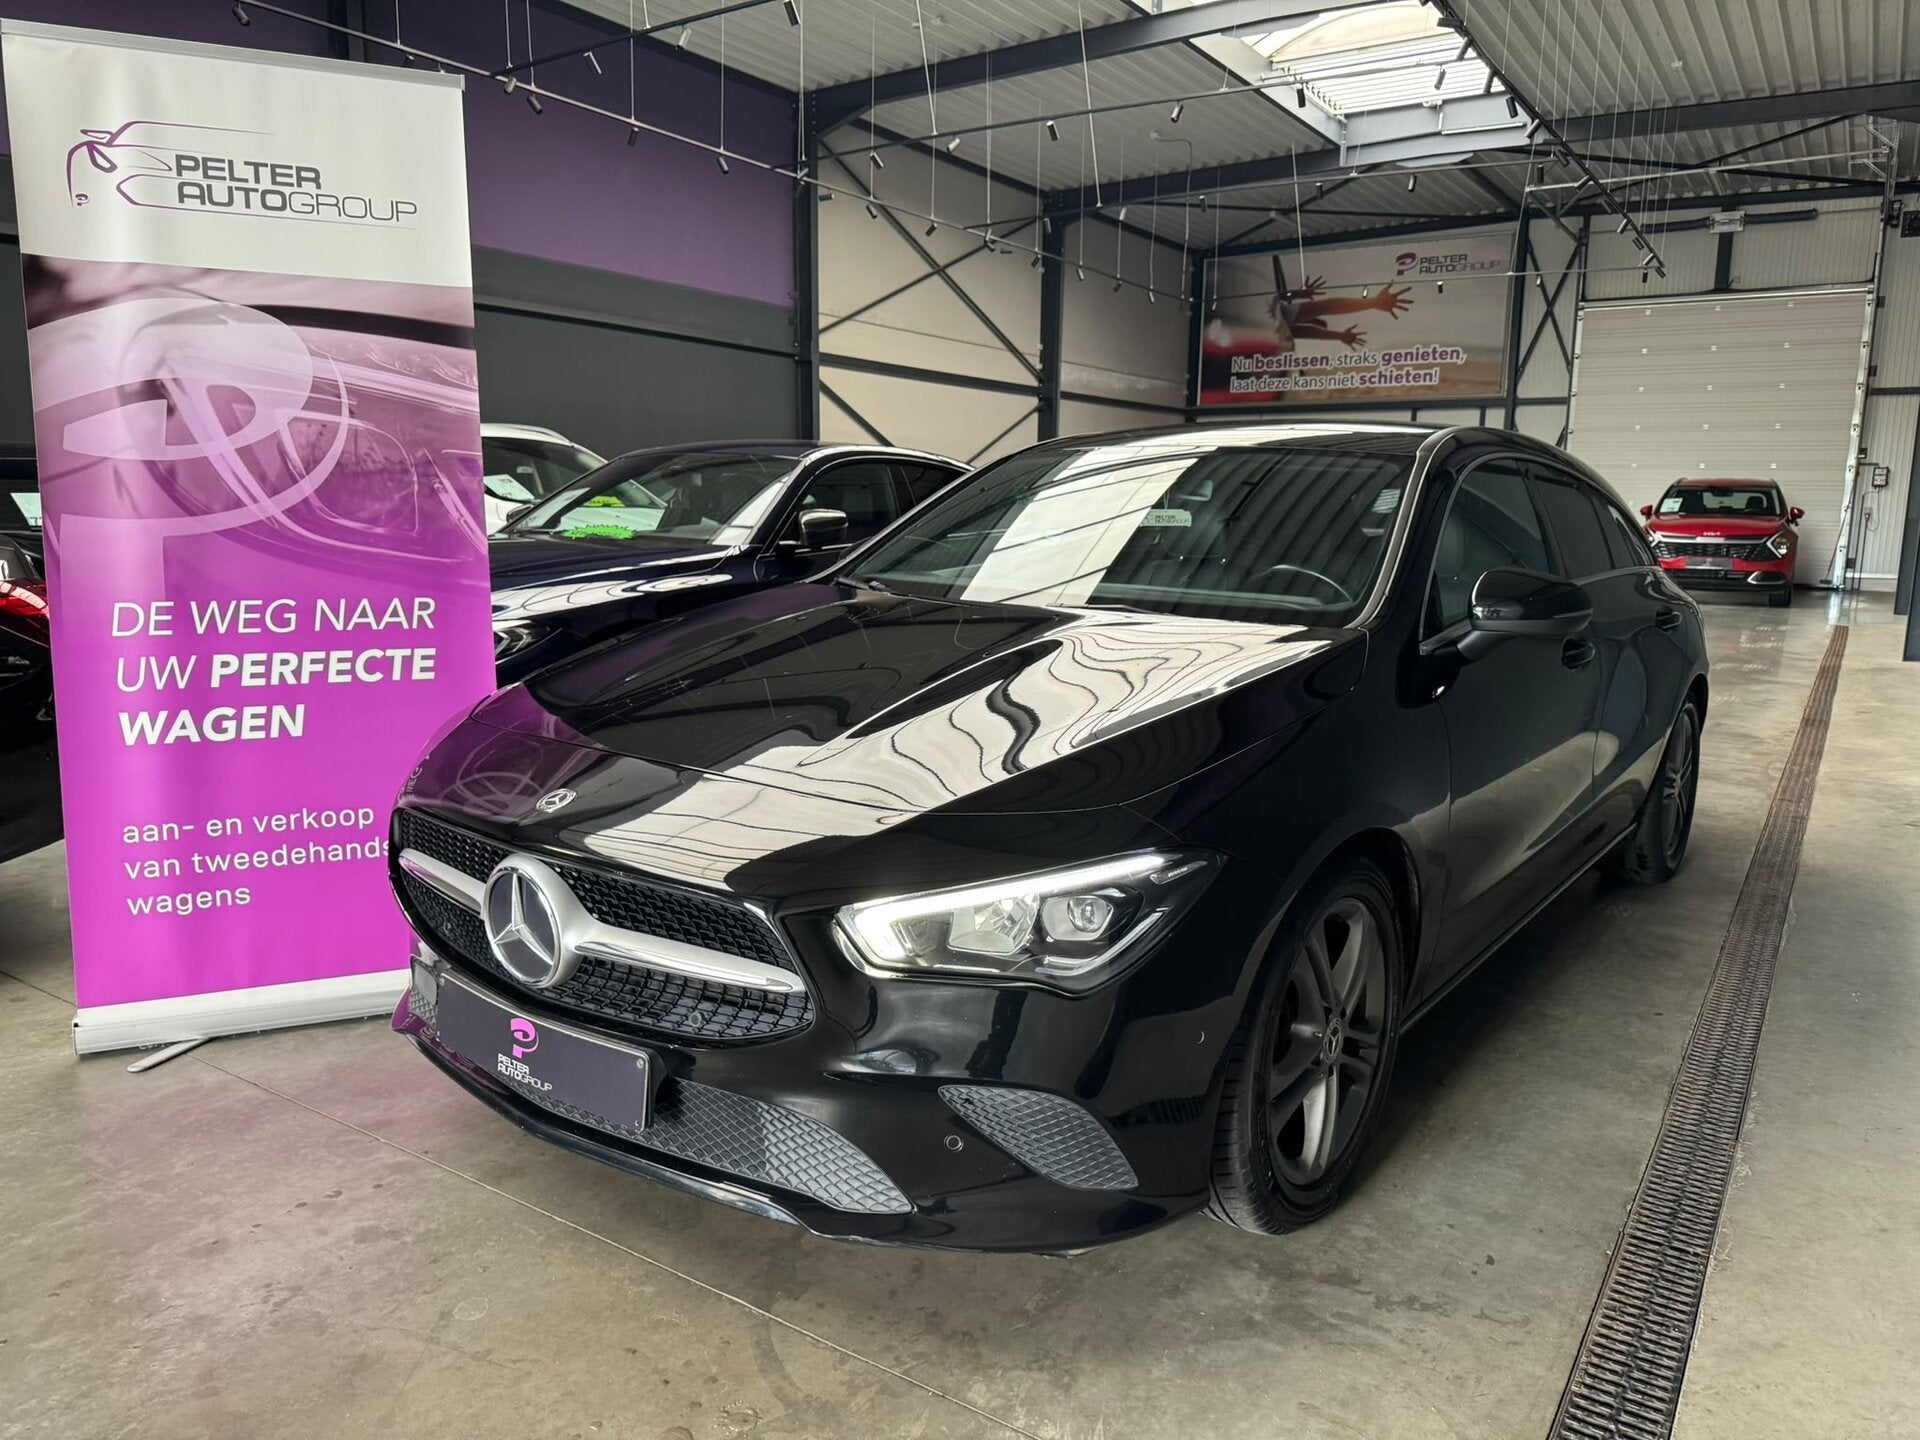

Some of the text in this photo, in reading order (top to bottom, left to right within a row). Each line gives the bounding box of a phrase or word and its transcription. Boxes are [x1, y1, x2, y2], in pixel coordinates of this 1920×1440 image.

[174, 153, 321, 190] PELTER
[177, 181, 418, 222] AUTOGROUP
[1418, 260, 1501, 274] AUTOGROUP
[1419, 253, 1468, 265] PELTER
[1233, 346, 1466, 371] Nu beslissen, straks genieten,
[1231, 369, 1438, 391] laat deze kans niet schieten!
[111, 597, 436, 637] DE WEG NAAR
[116, 647, 437, 692] UW PERFECTE
[118, 704, 305, 746] WAGEN
[122, 806, 375, 844] aan- en verkoop
[123, 860, 180, 880] van
[126, 887, 251, 917] wagens
[498, 1053, 530, 1075] PELTER
[498, 1063, 553, 1092] AUTOGROUP
